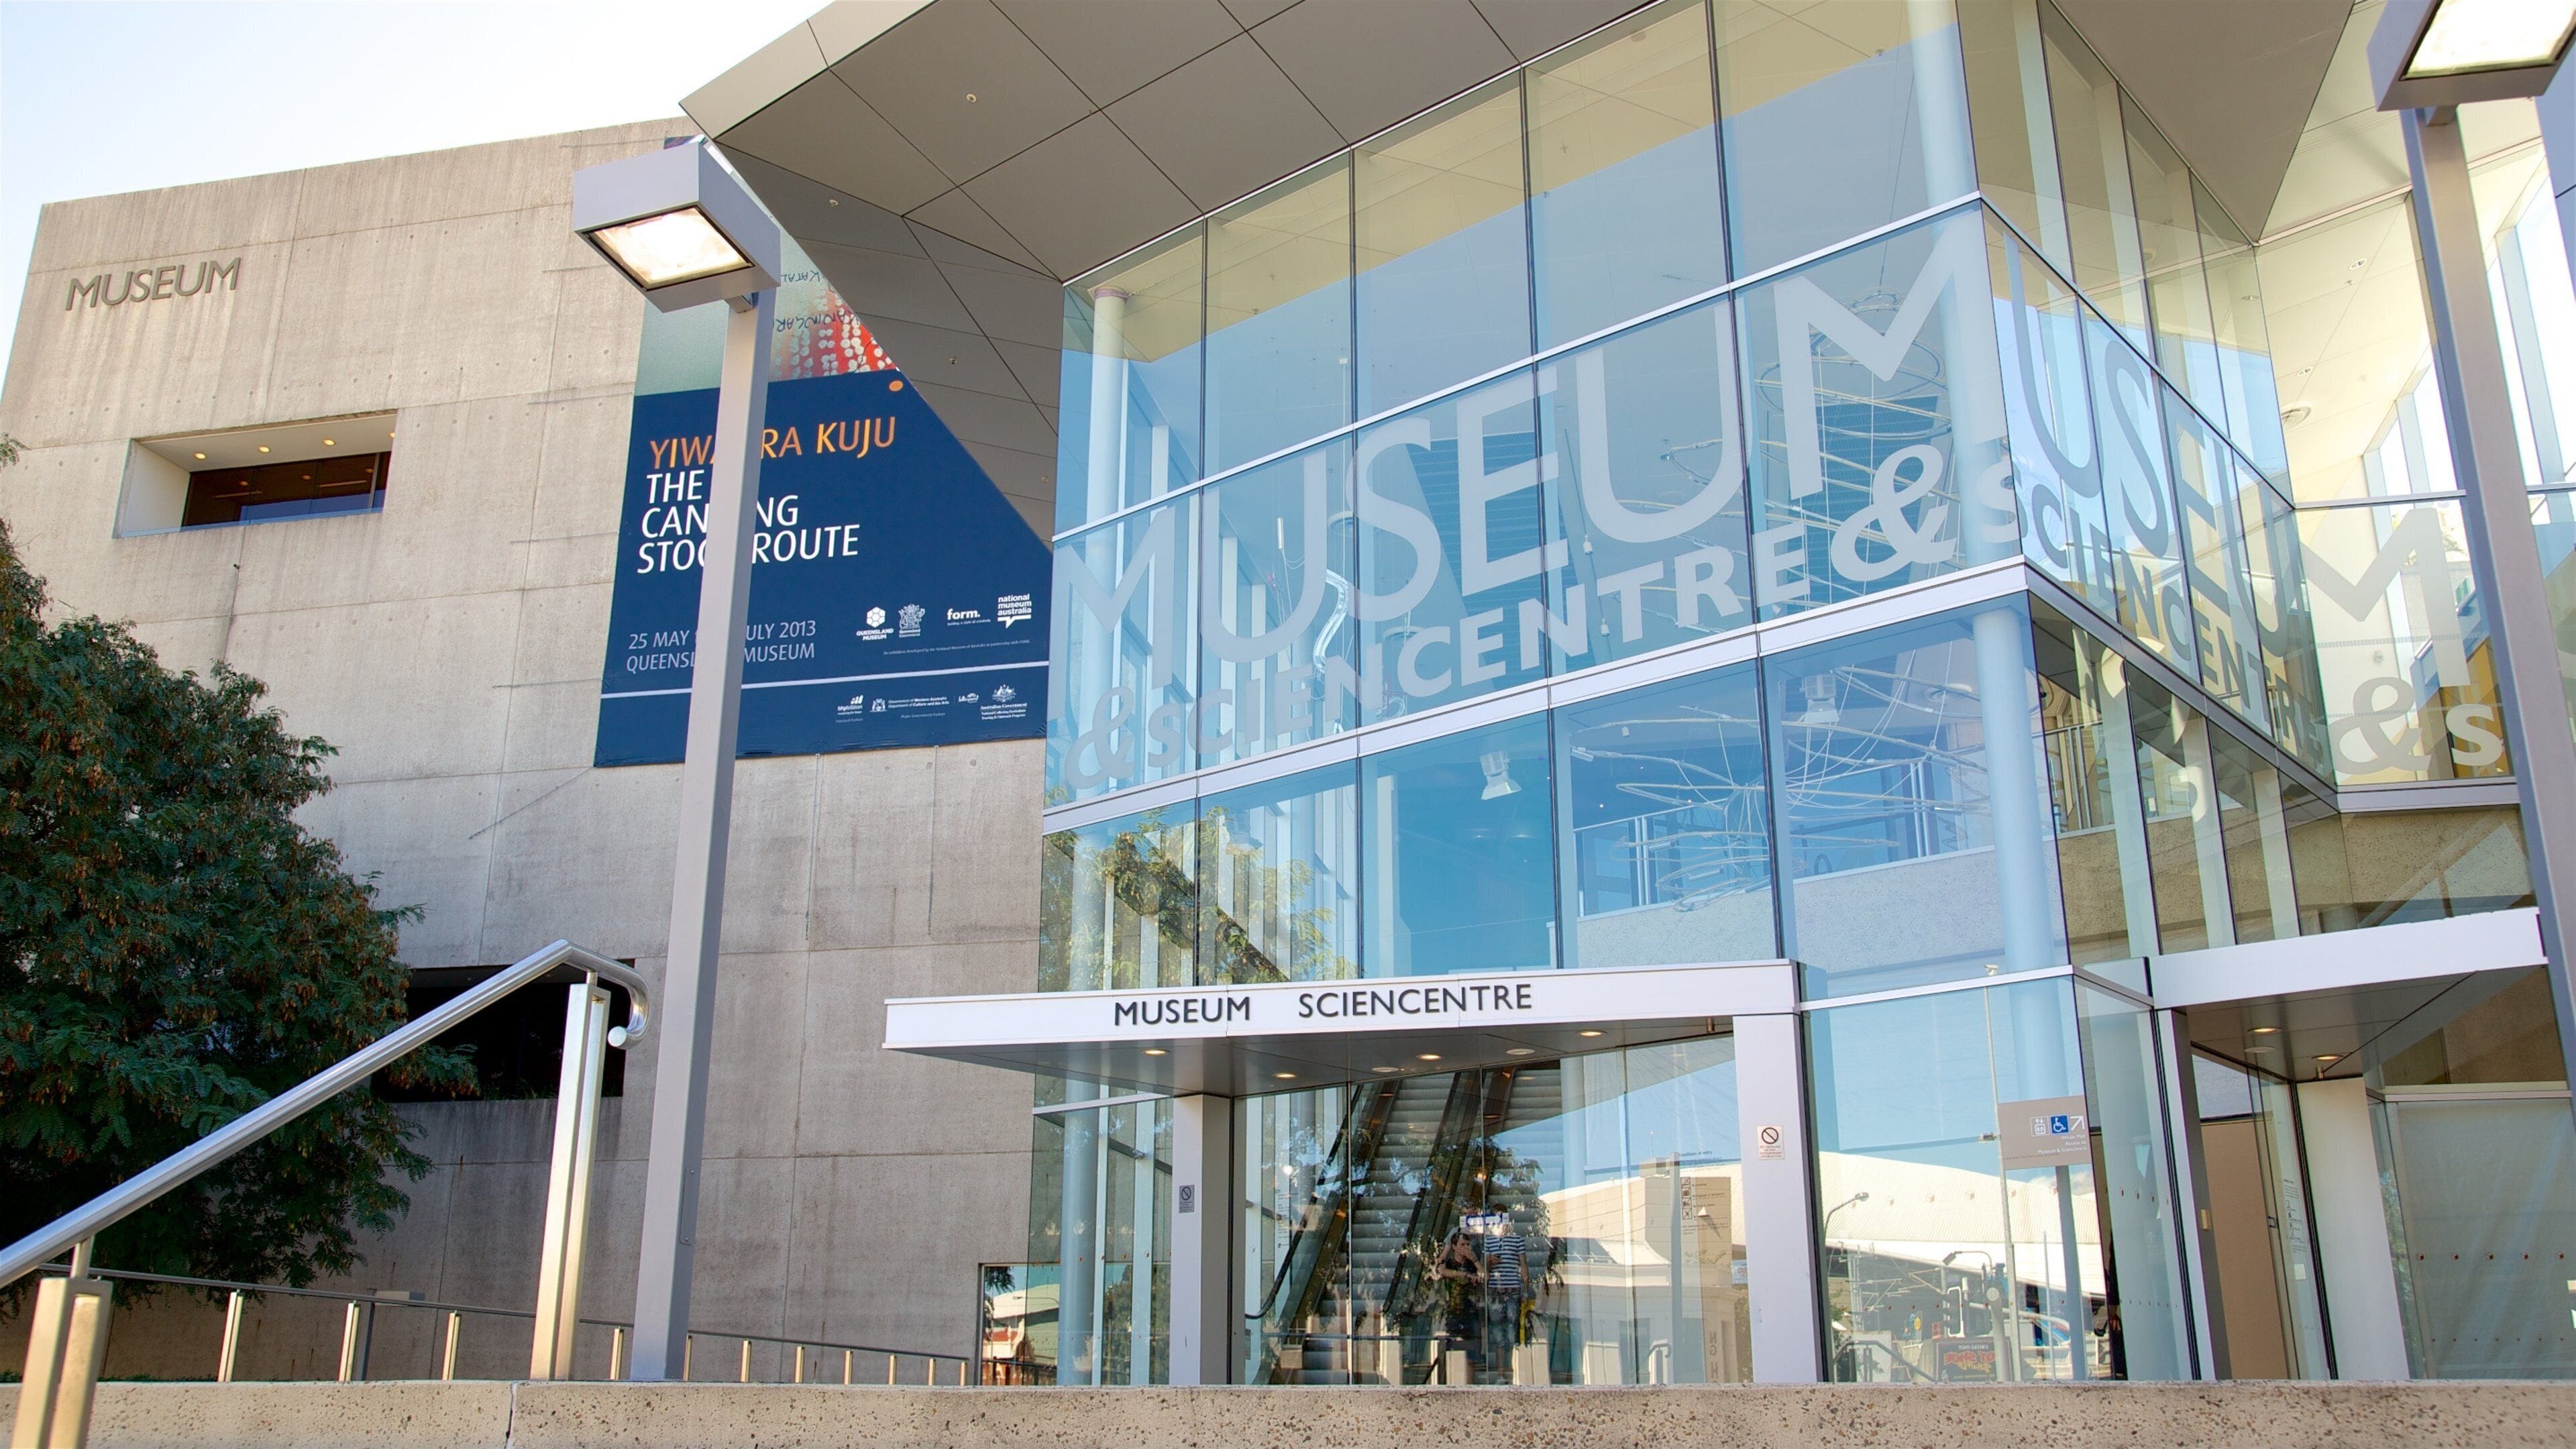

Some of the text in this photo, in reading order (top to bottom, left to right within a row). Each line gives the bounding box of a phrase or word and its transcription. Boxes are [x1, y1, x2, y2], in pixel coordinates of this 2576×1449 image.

[65, 257, 241, 311] MUSEUM
[650, 416, 896, 470] YIWRA KUJU
[1046, 208, 2006, 722] MUSEUM
[647, 470, 705, 504] THE
[641, 495, 799, 538] CANNG
[637, 524, 860, 574] STO ROUTE
[947, 608, 981, 620] form.
[998, 593, 1030, 602] national
[998, 601, 1032, 609] museum
[998, 607, 1031, 616] australia
[628, 620, 816, 649] 25 MAY ULY 2013
[856, 628, 894, 636] QUEENSLAND
[1148, 521, 1811, 767] SCIENCENTRE
[627, 643, 815, 674] QUEENSL MUSEUM
[1114, 983, 1532, 1026] MUSEUM SCIENCENTRE
